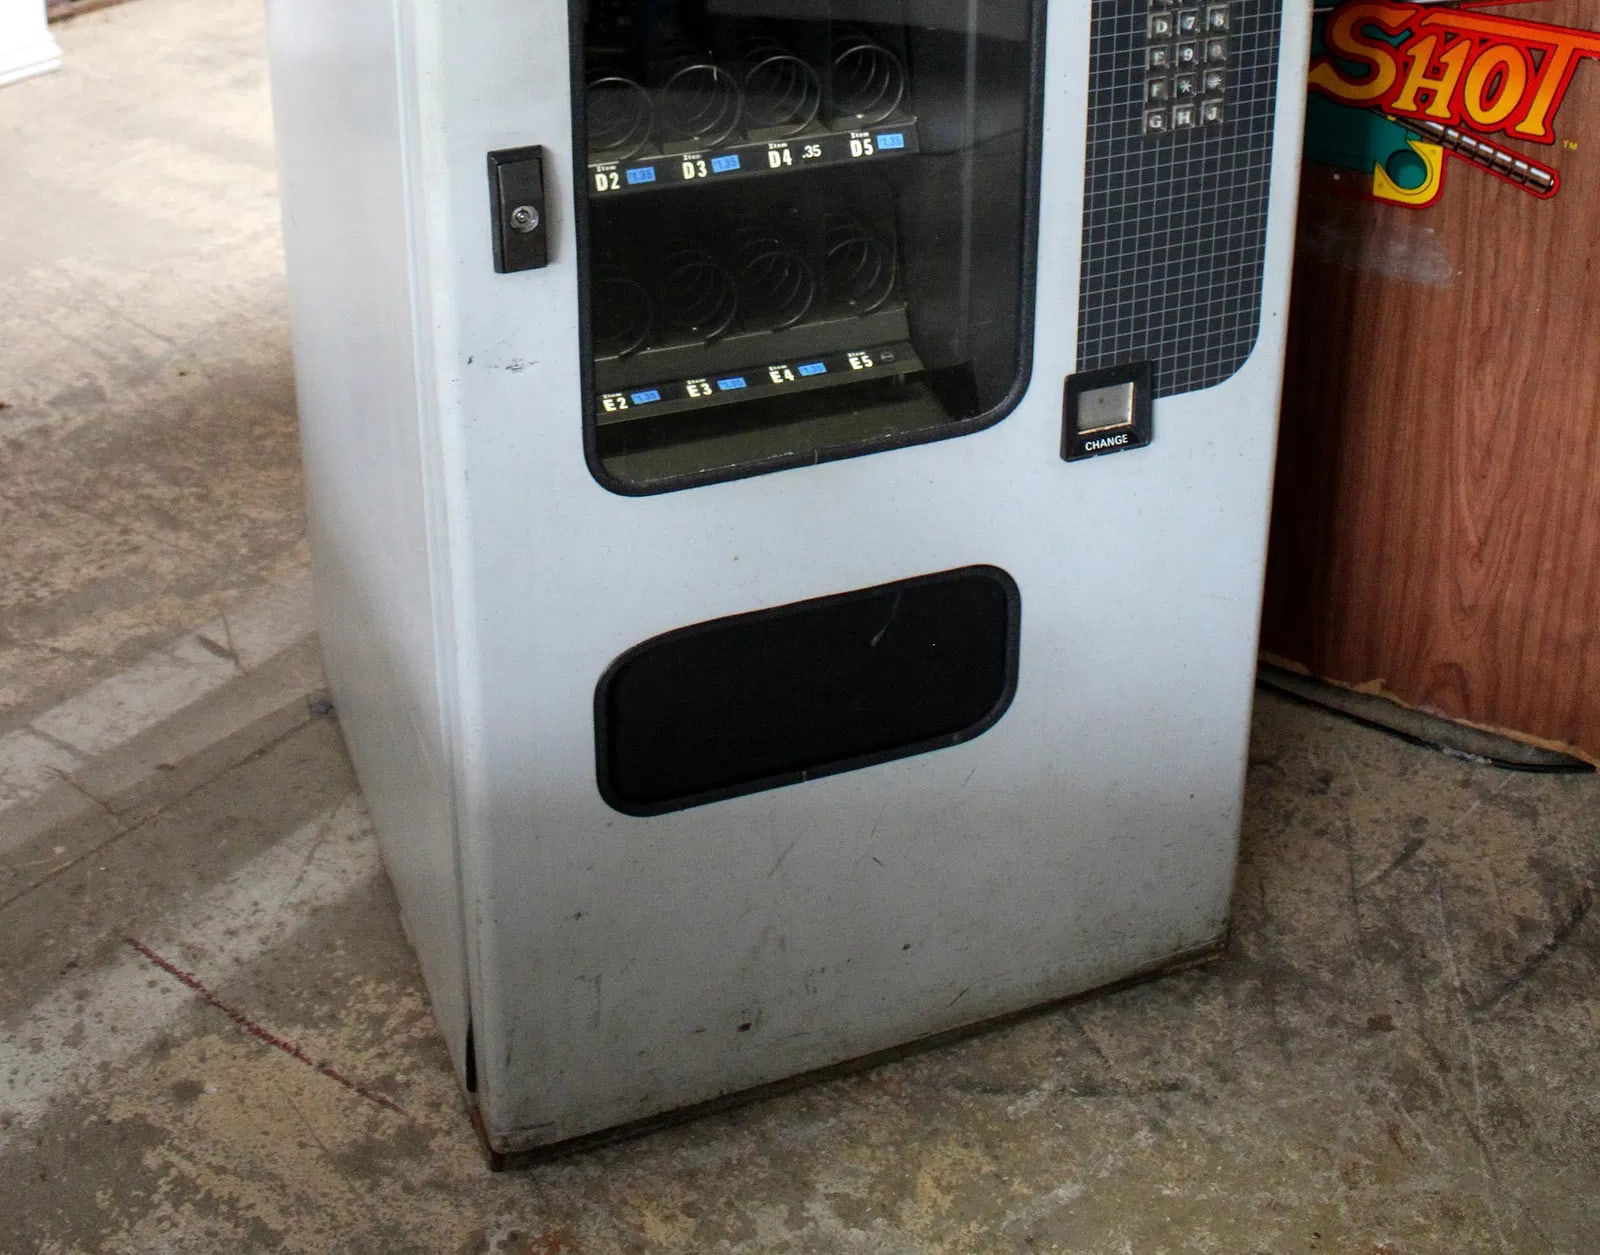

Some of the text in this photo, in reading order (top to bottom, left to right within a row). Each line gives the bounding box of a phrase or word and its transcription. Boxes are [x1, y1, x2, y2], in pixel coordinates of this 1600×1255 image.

[1156, 20, 1168, 34] D
[1184, 16, 1195, 30] 7
[1184, 48, 1194, 61] 9
[1307, 1, 1600, 137] SHOT
[1149, 107, 1218, 128] G H J
[1563, 140, 1578, 151] TM
[595, 172, 621, 192] D2
[682, 161, 708, 180] D3
[768, 149, 792, 169] D4
[802, 144, 822, 159] .35
[850, 139, 874, 158] D5
[602, 398, 629, 412] E2
[686, 383, 713, 398] E3
[769, 369, 795, 384] E4
[848, 356, 874, 371] E5
[1085, 434, 1129, 451] CHANGE
